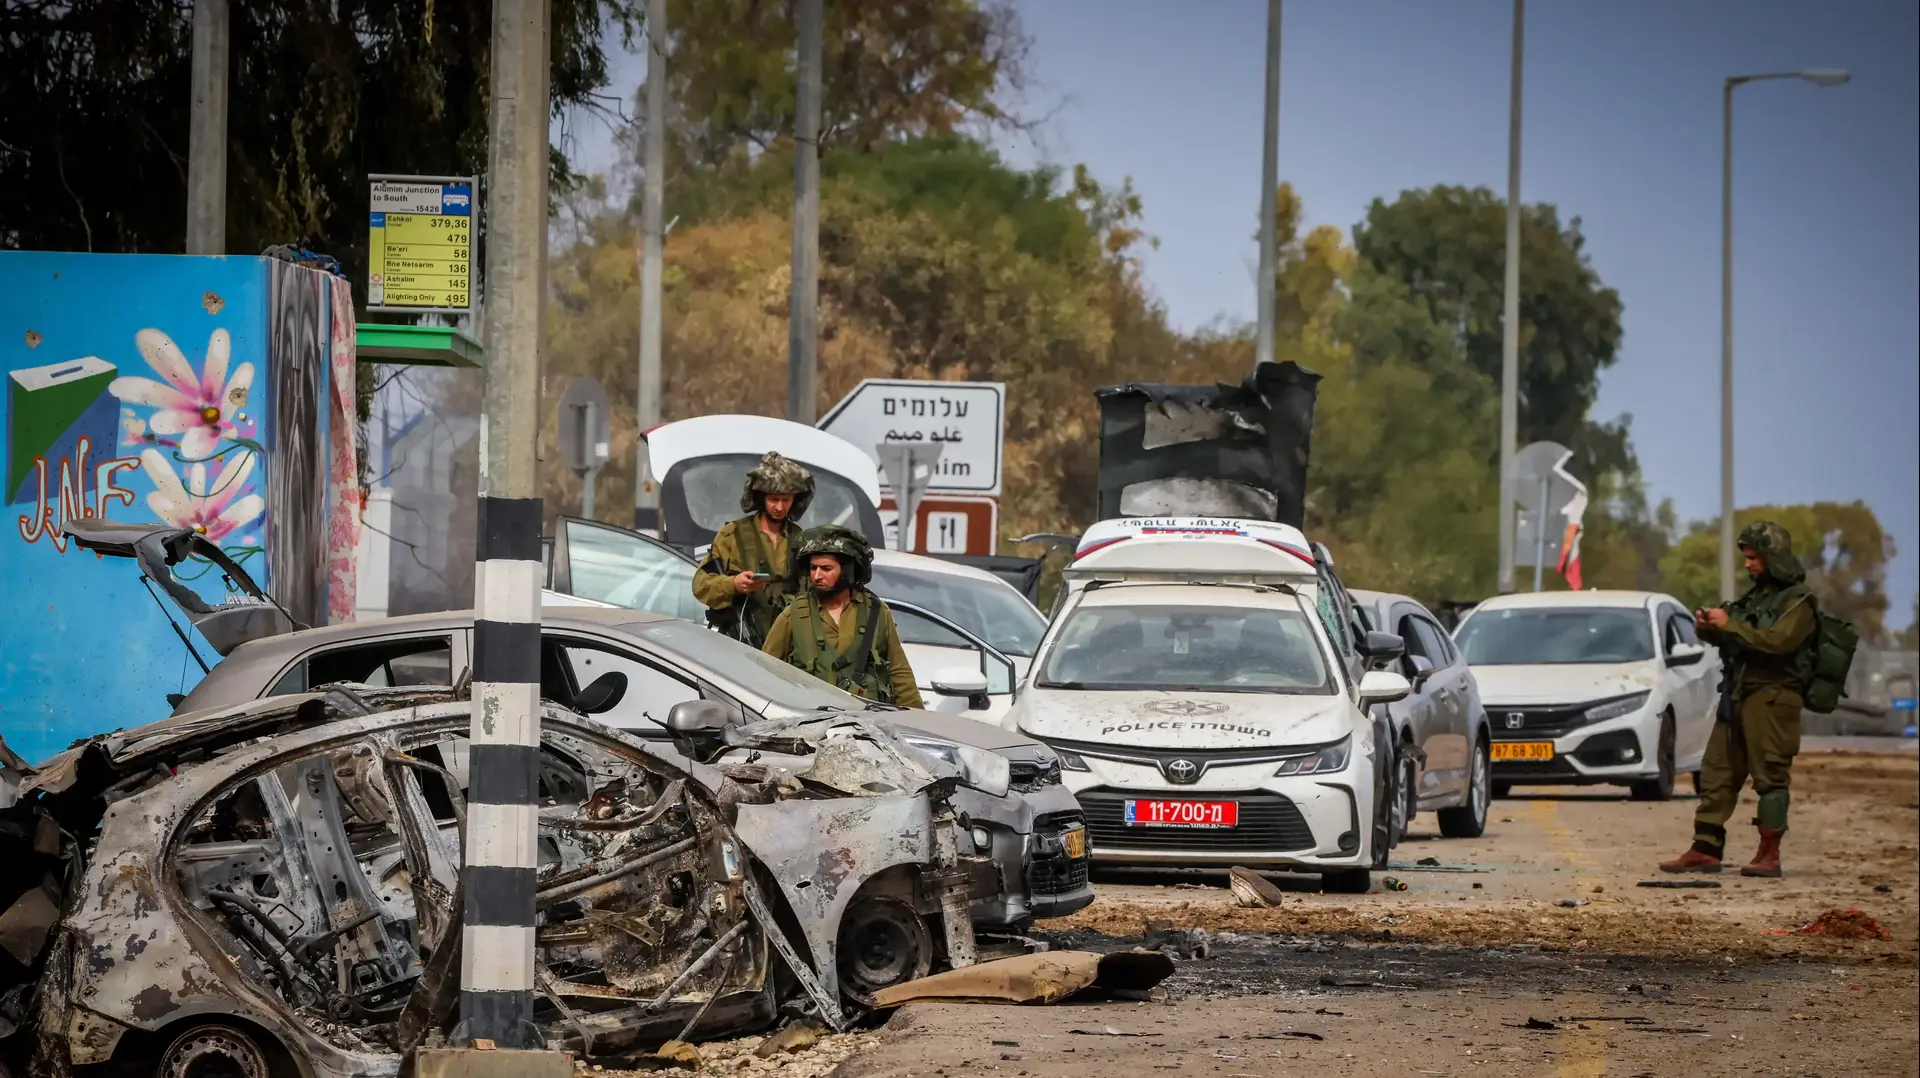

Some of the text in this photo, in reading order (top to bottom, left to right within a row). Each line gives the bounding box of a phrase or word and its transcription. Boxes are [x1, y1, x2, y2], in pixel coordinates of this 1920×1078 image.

[384, 194, 408, 202] South
[416, 205, 440, 213] 15426
[431, 219, 467, 229] 379,36
[447, 234, 467, 243] 479
[454, 250, 467, 258] 58
[449, 264, 466, 273] 136
[448, 280, 466, 288] 145
[446, 295, 466, 303] 495
[883, 397, 968, 417] עלומים
[1102, 722, 1271, 737] POLICE משטרה
